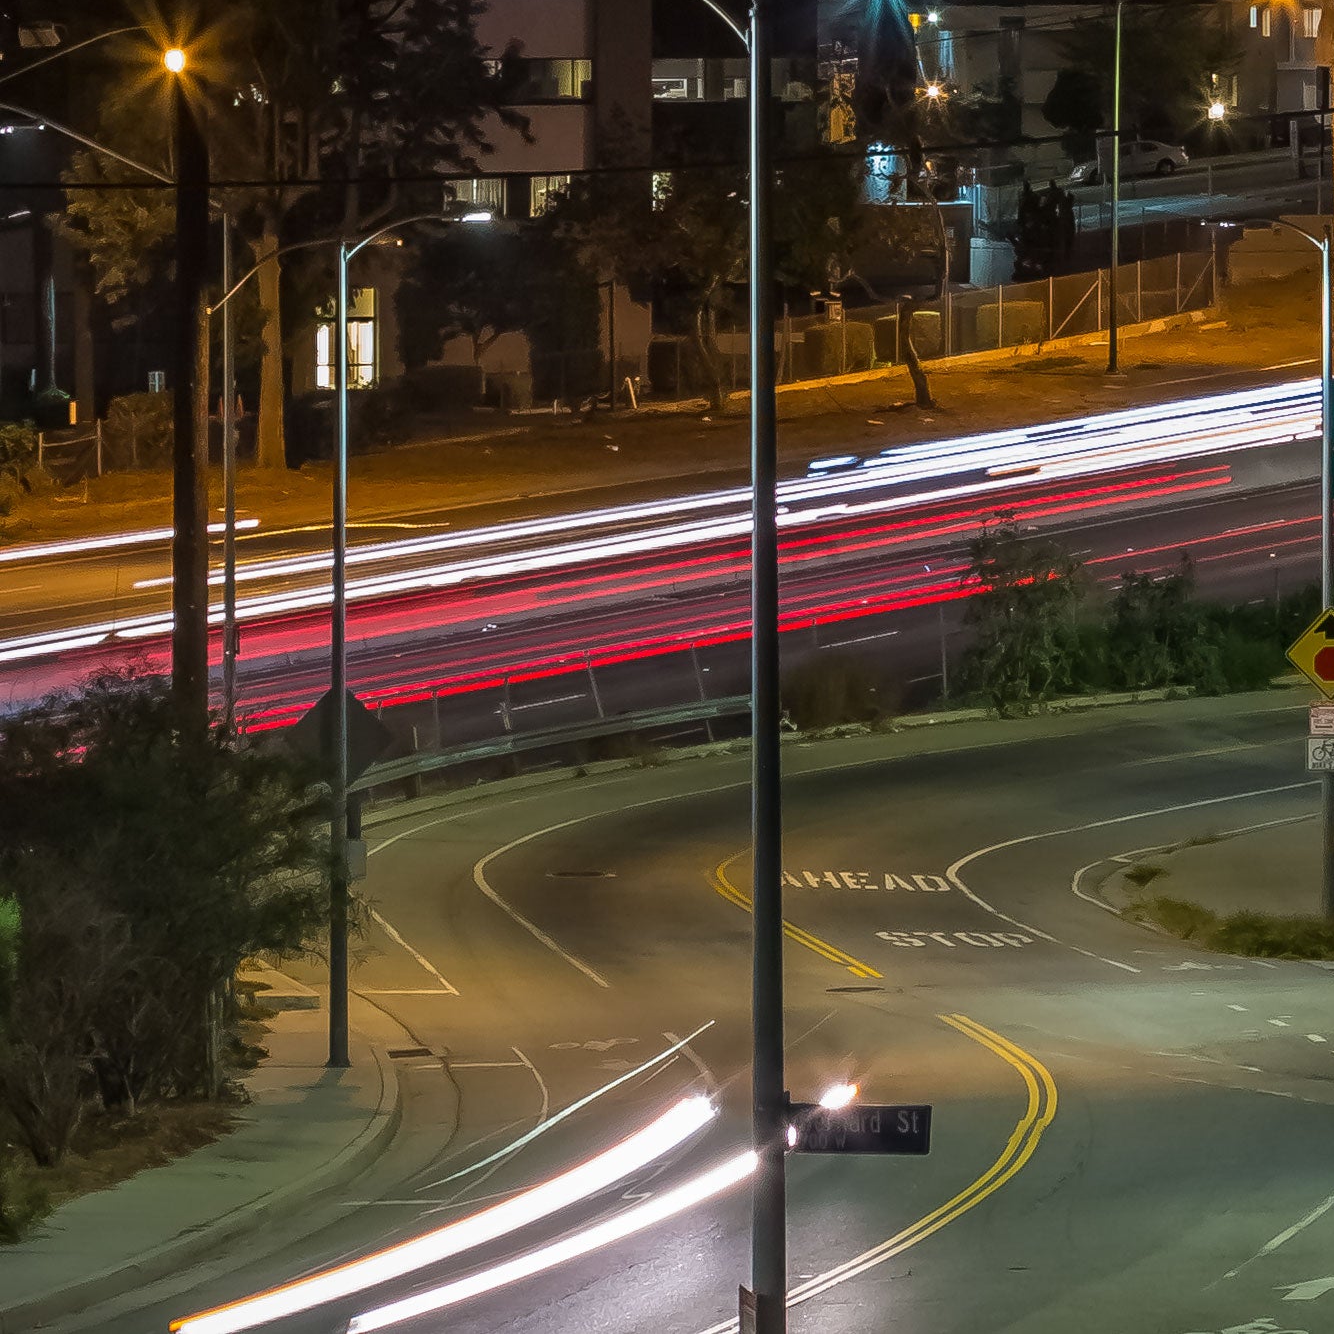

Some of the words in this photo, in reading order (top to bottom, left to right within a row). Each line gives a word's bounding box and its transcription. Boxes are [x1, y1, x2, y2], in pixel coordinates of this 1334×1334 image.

[781, 870, 951, 892] AHEAD
[874, 931, 1035, 948] STOP
[897, 1110, 919, 1134] St
